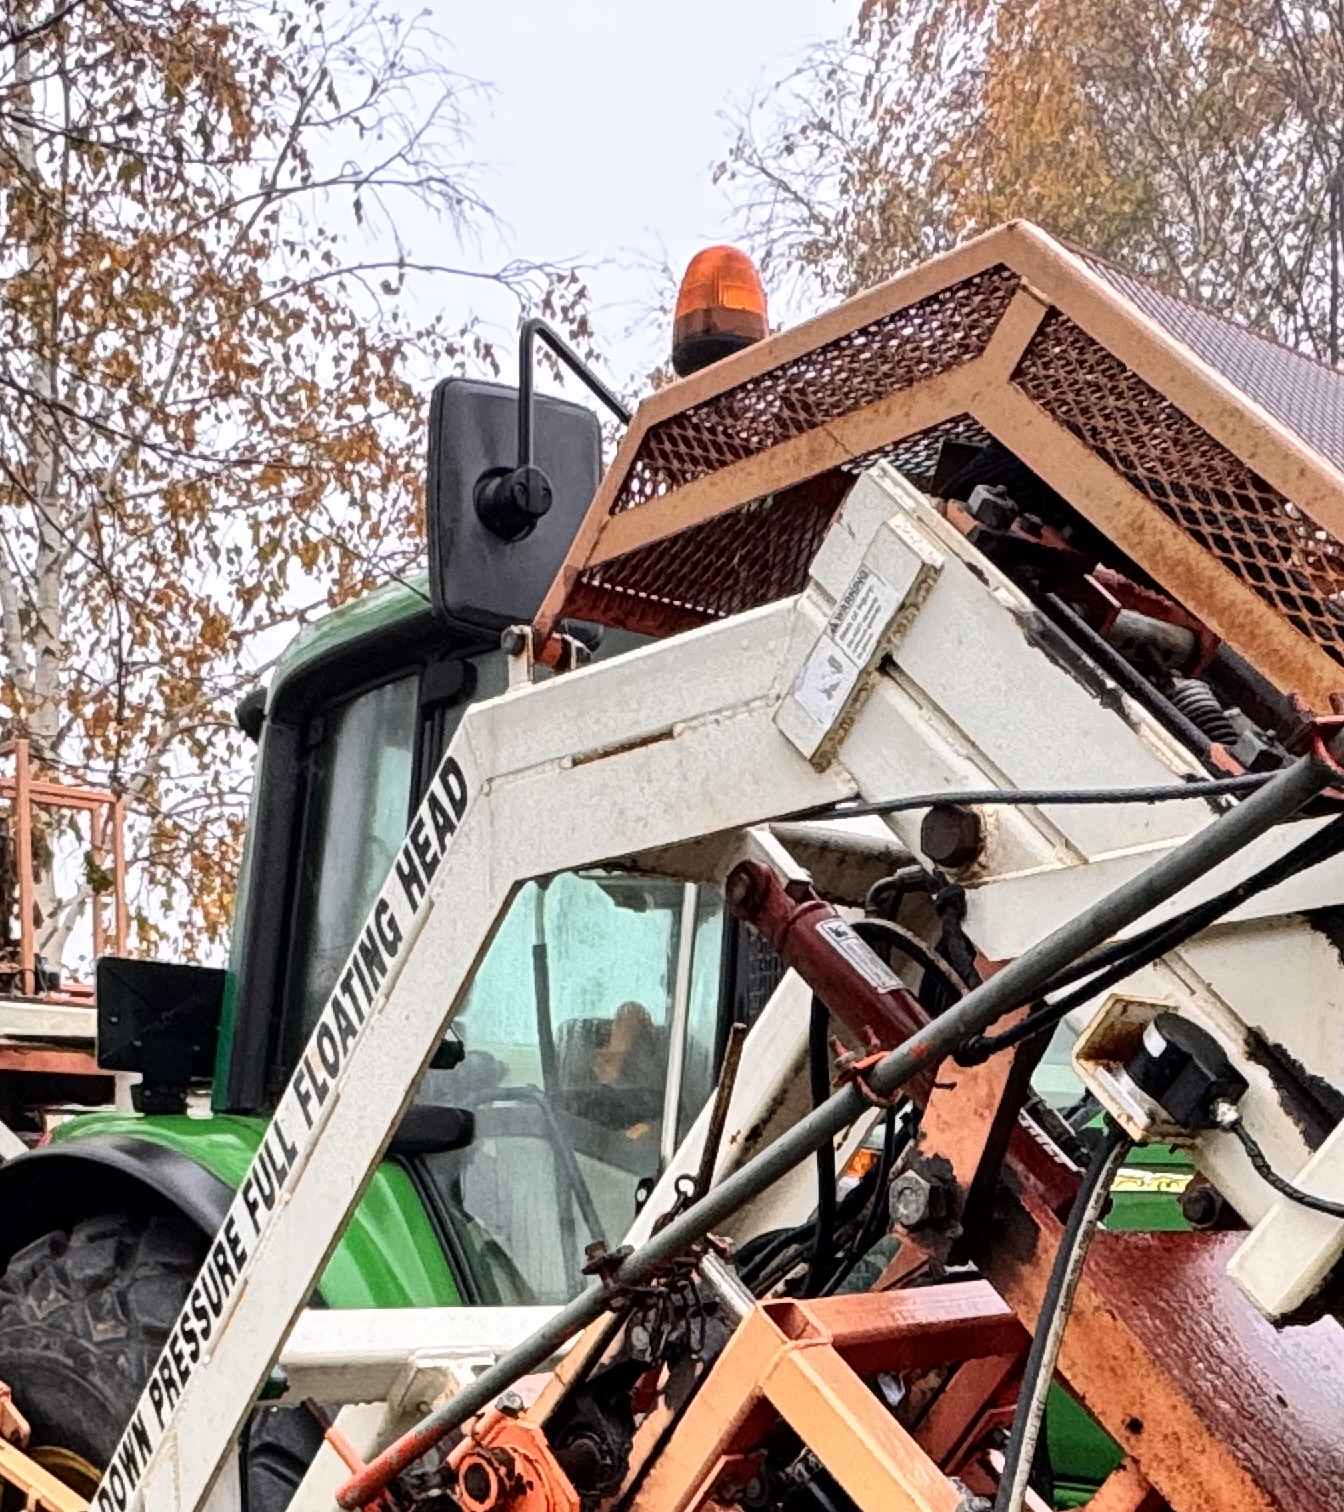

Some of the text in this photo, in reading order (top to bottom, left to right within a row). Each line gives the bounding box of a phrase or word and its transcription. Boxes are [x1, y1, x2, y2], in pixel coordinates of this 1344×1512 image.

[149, 1212, 248, 1431] PRESSURE
[242, 1119, 298, 1237] FULL
[292, 898, 403, 1130] FLOATING
[395, 756, 468, 915] HEAD
